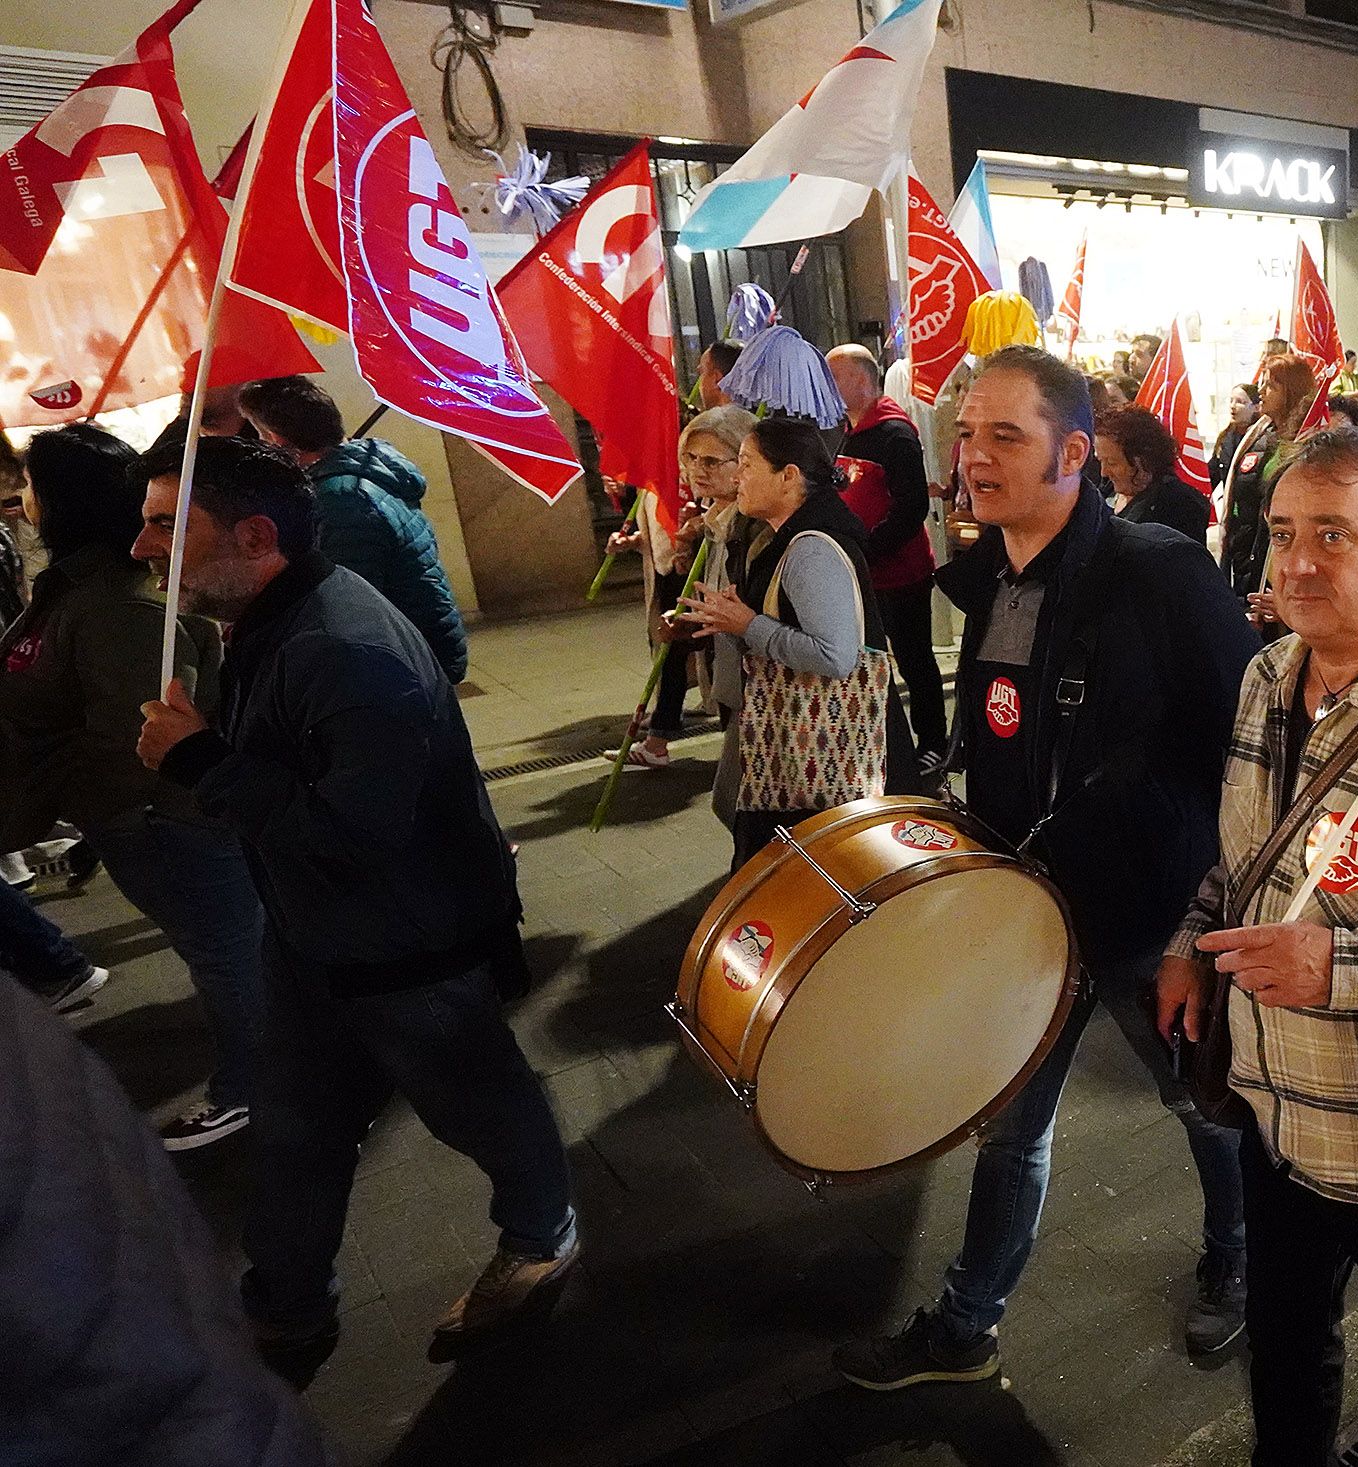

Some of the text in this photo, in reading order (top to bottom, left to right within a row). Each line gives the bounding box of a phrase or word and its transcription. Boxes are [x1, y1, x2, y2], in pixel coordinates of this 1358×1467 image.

[14, 174, 44, 228] Galega
[1204, 149, 1336, 204] KRACK
[537, 251, 604, 316] Confederación
[600, 308, 655, 366] Intersindical
[652, 362, 678, 397] Galega
[990, 681, 1017, 709] UGT
